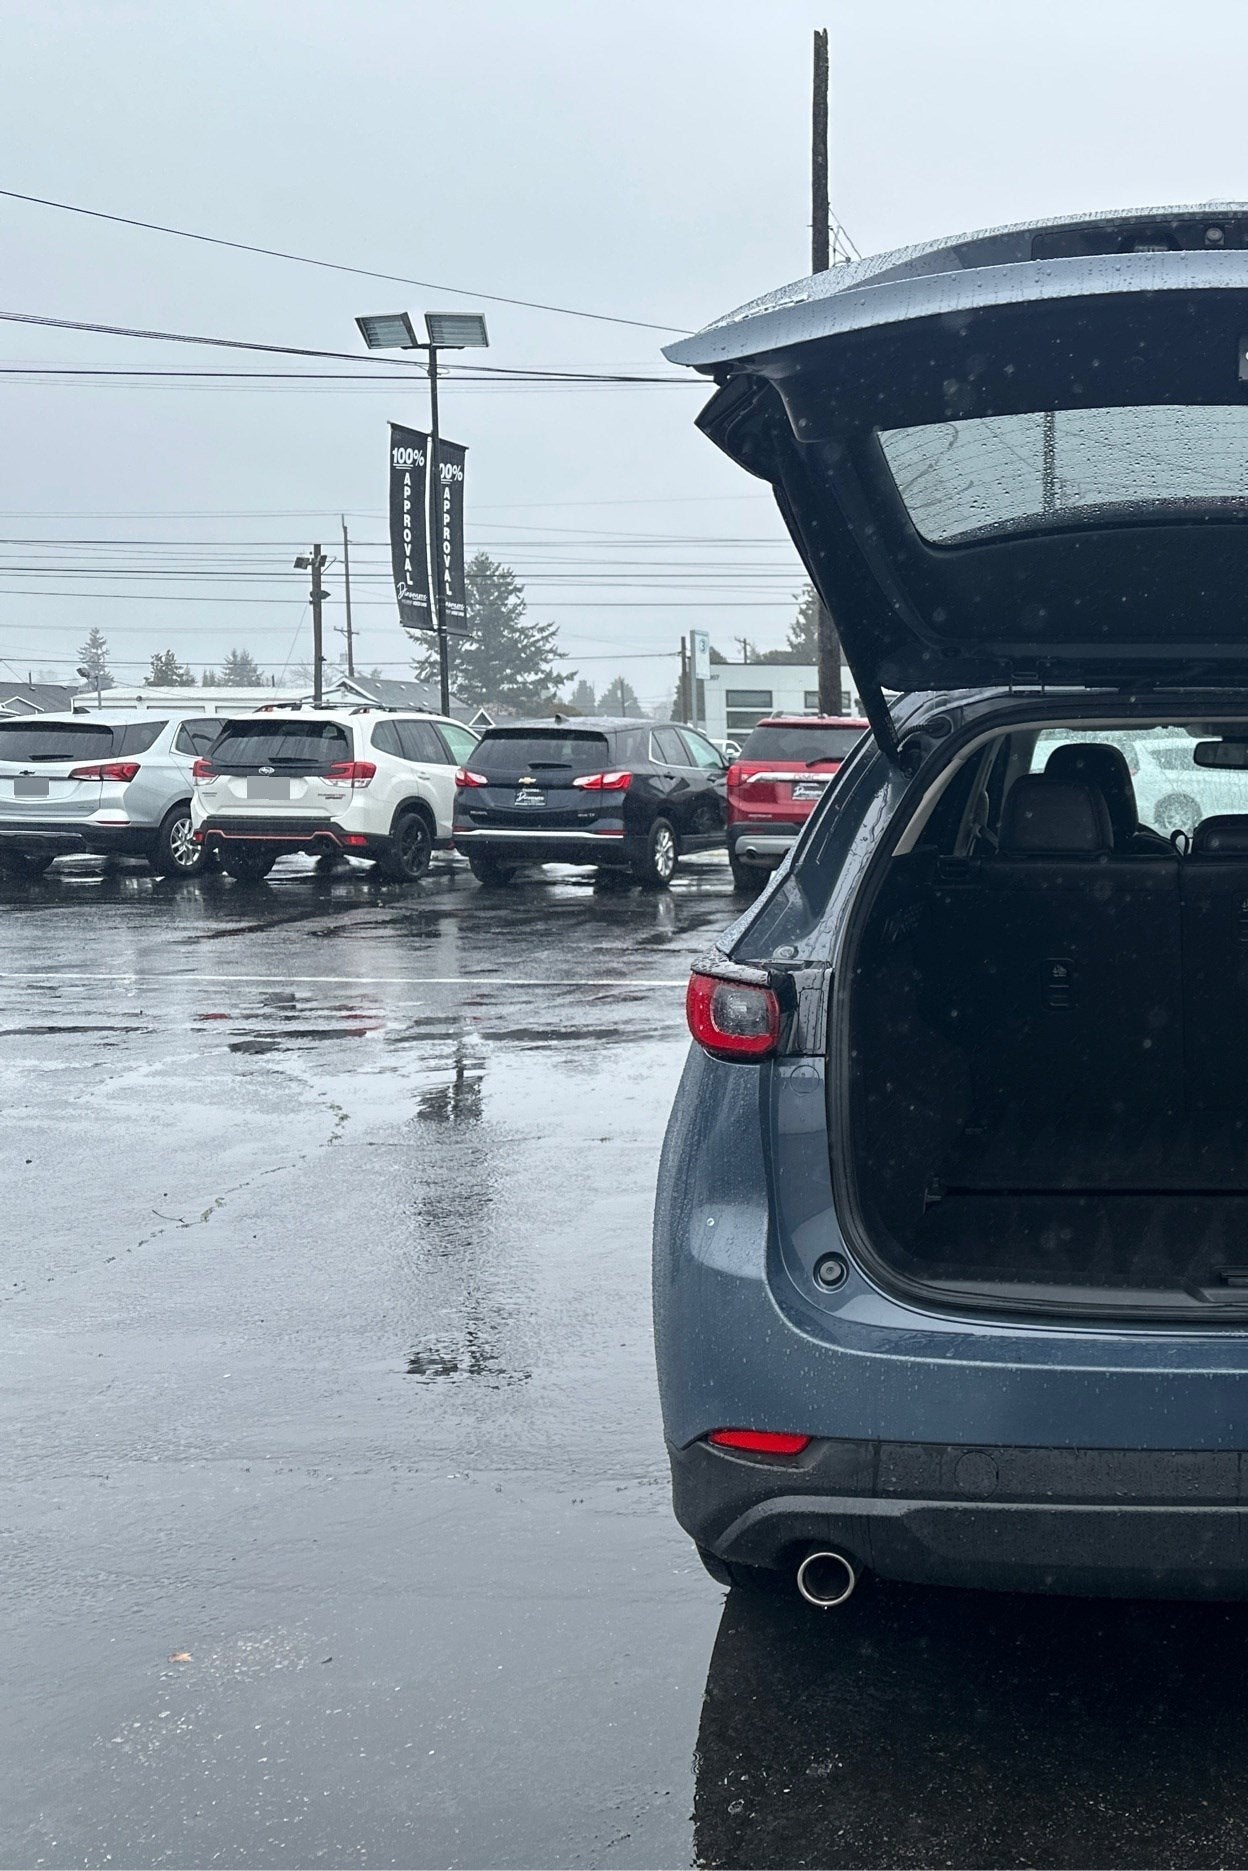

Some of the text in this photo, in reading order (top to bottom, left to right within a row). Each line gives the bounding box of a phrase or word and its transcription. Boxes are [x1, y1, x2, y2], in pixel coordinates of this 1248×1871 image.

[392, 447, 425, 467] 100%
[439, 462, 463, 481] 00%
[404, 472, 413, 585] APPROVAL
[443, 487, 452, 595] APPROVAL
